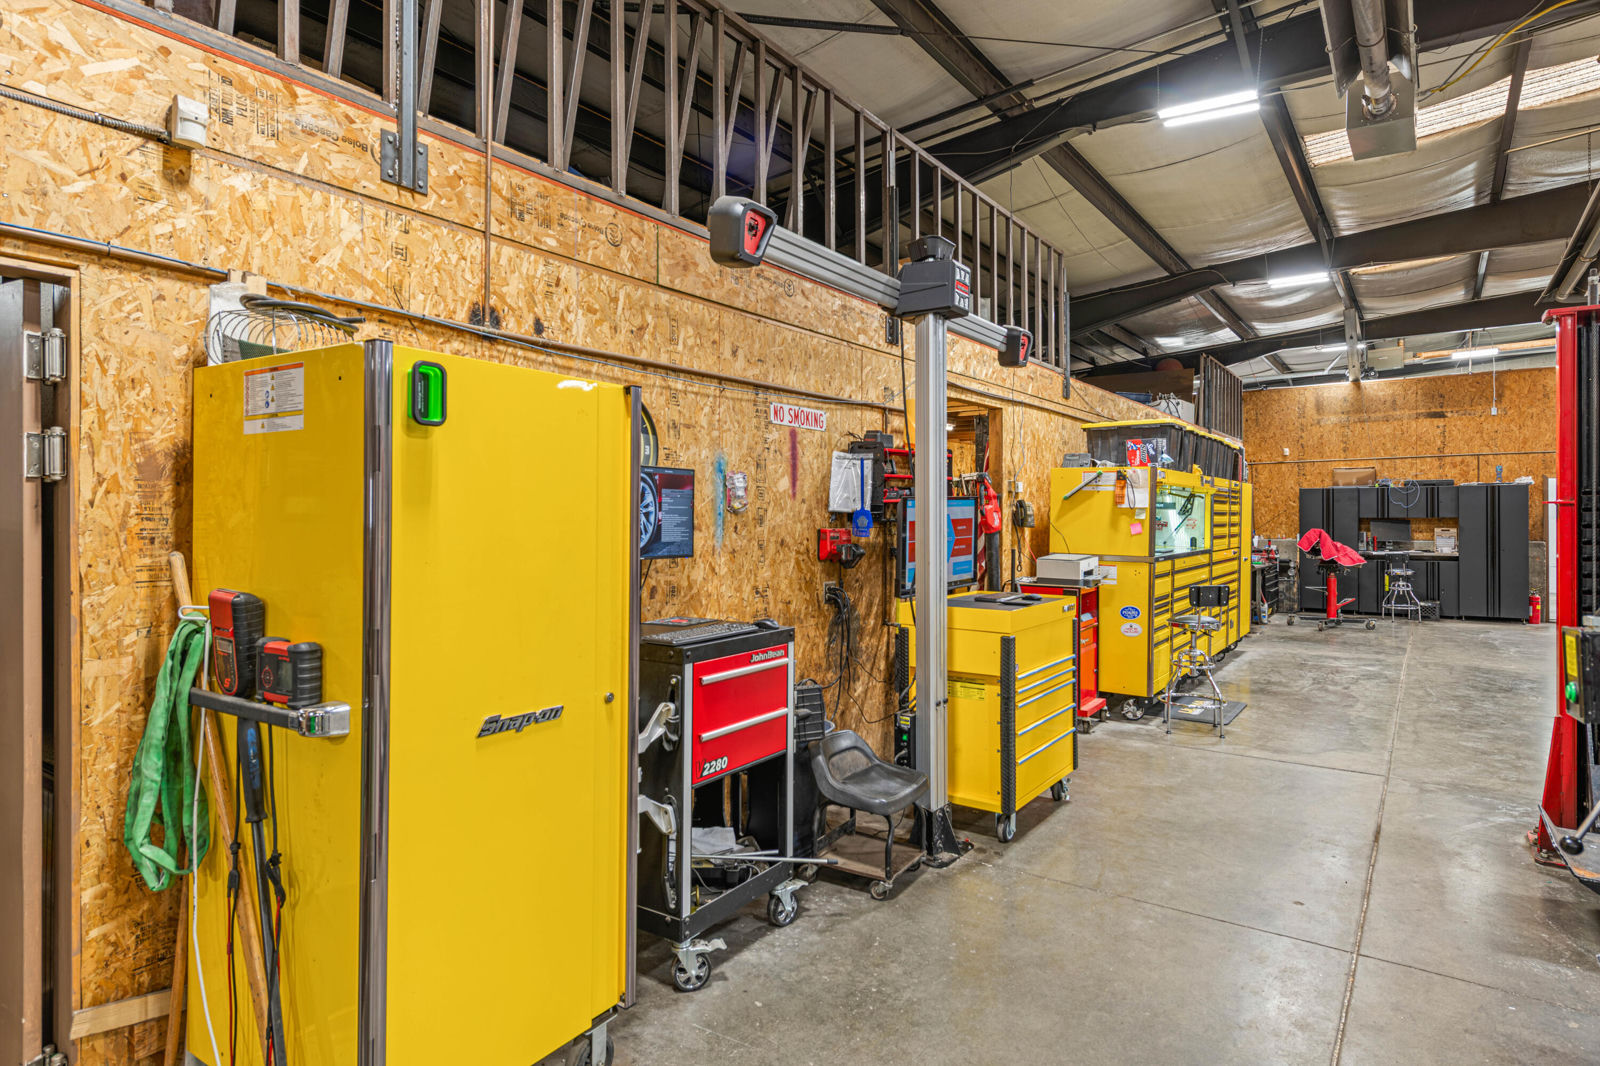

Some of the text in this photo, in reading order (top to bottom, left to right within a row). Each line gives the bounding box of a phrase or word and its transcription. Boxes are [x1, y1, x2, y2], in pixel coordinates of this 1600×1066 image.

[773, 404, 785, 423] NO
[788, 407, 824, 429] SMOKING
[749, 650, 785, 663] JohnBean
